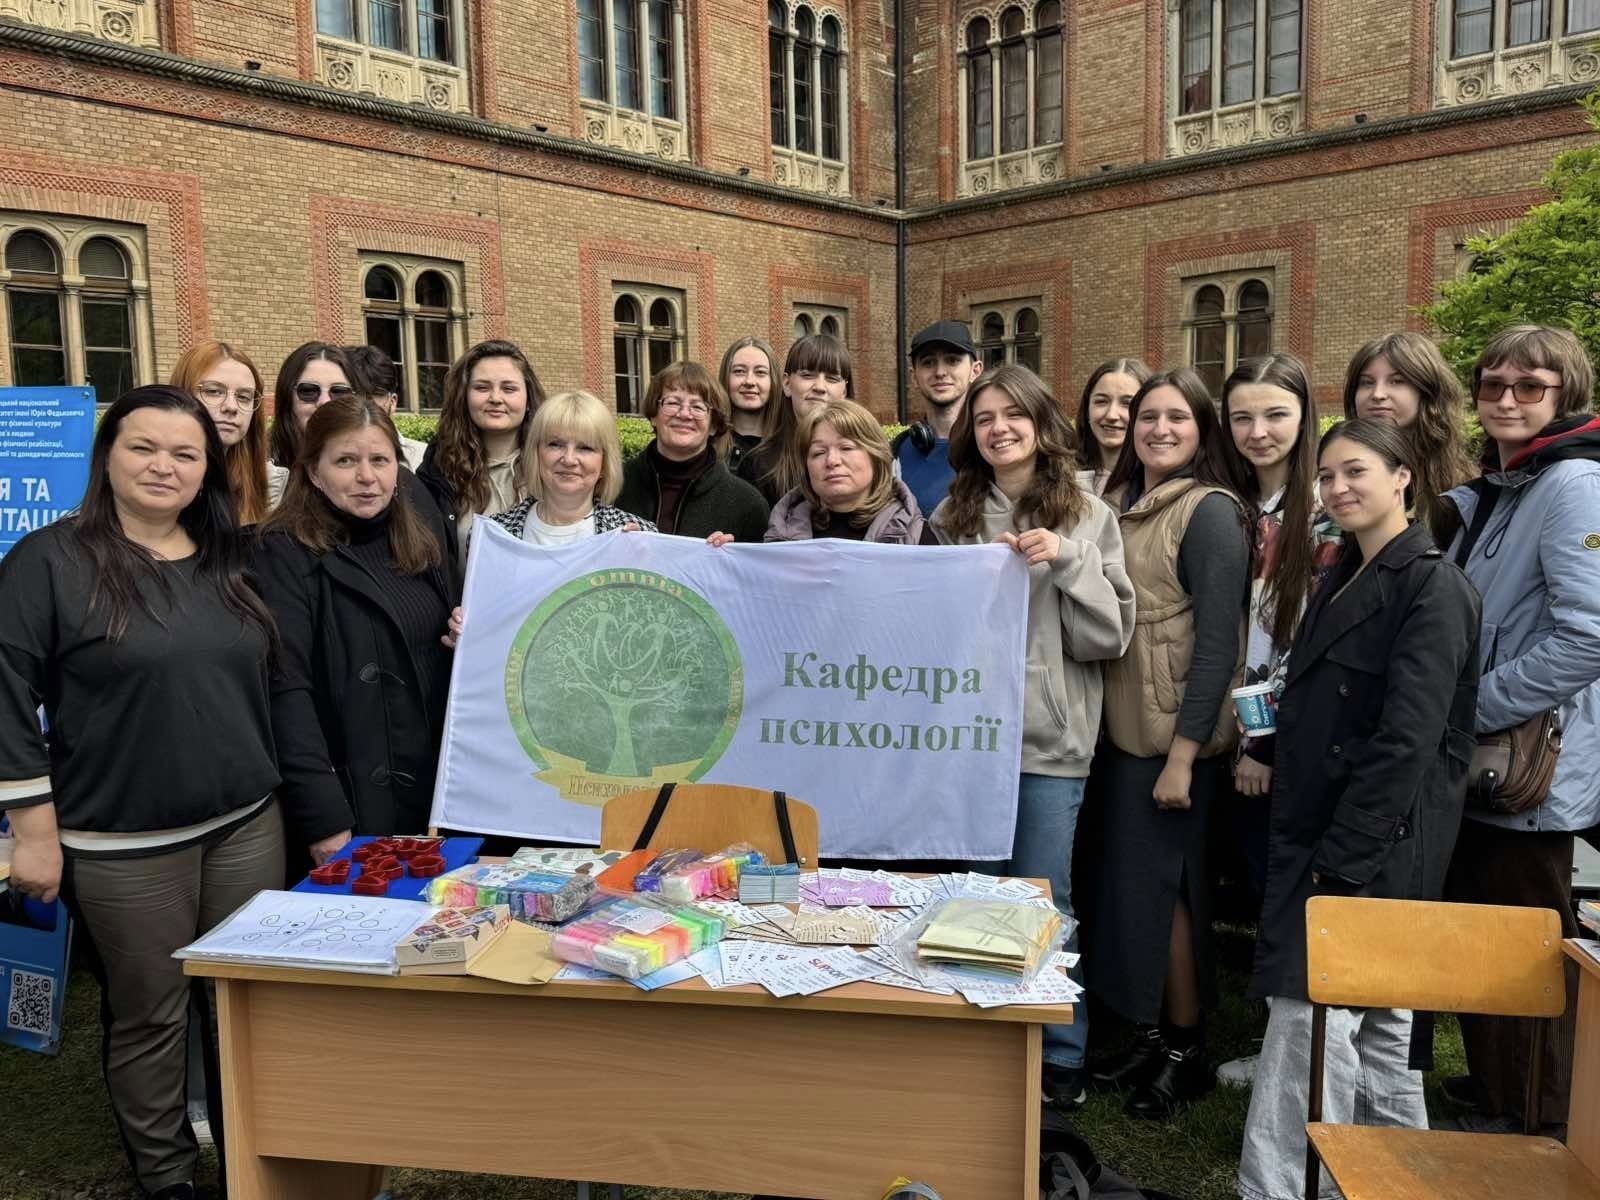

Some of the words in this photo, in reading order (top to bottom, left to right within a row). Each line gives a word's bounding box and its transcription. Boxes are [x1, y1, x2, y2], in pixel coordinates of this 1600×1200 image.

[22, 477, 51, 502] ТА
[780, 652, 983, 704] Кафедра
[759, 714, 1003, 751] психології
